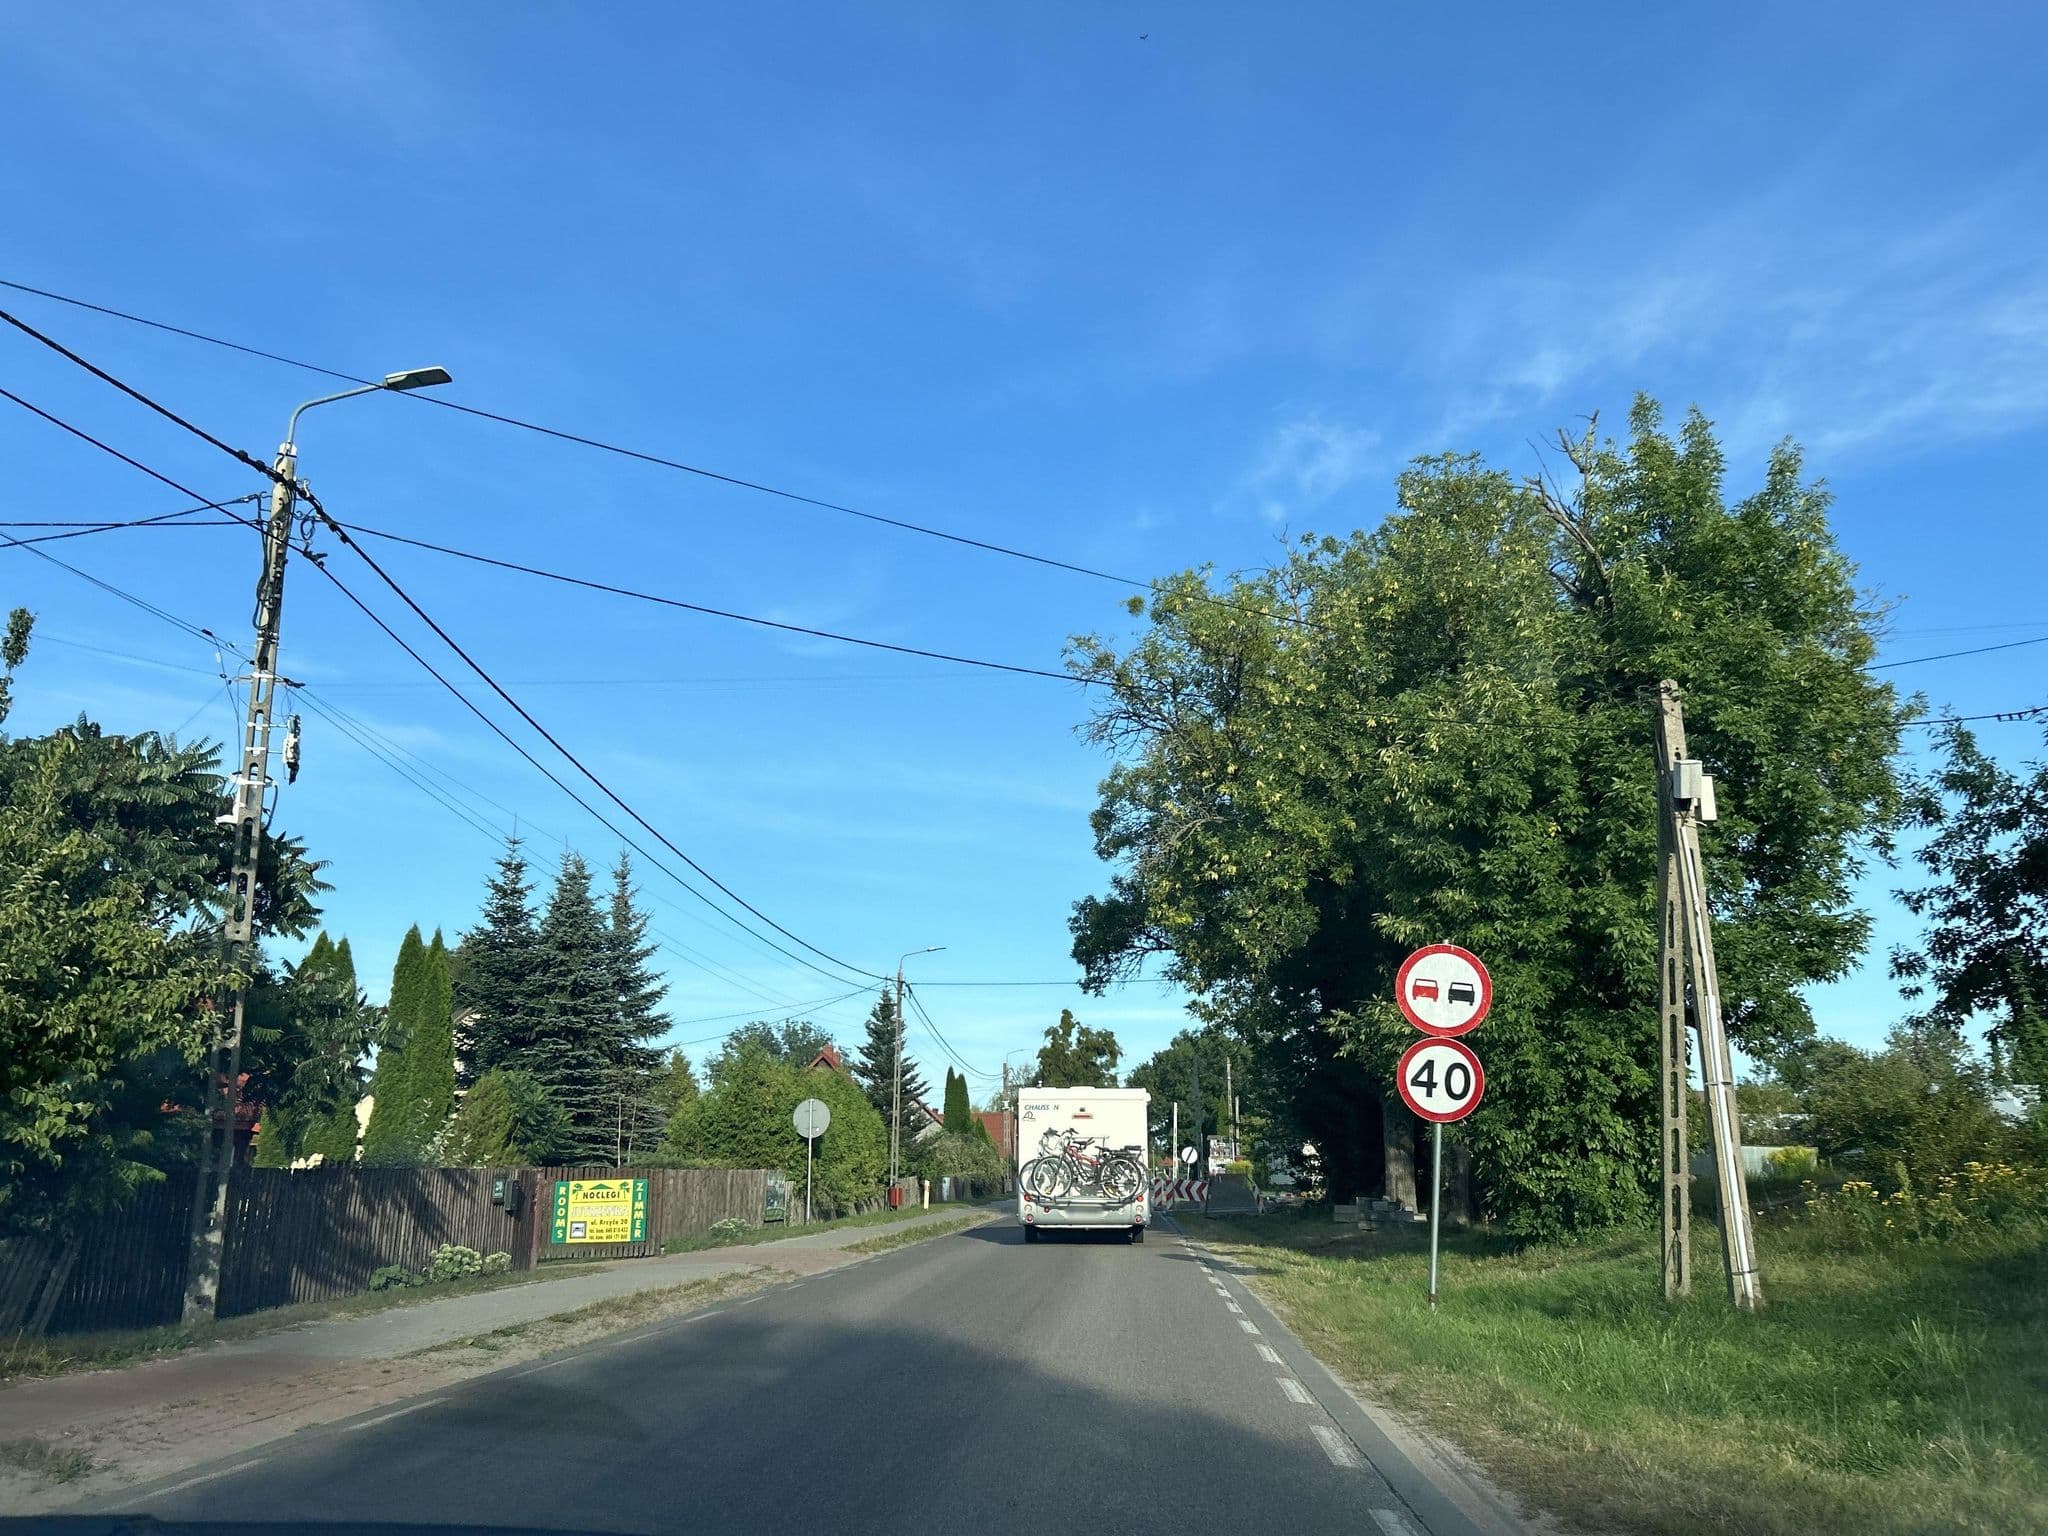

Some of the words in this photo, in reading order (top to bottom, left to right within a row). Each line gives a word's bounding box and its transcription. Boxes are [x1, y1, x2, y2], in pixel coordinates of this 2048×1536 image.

[1410, 1059, 1471, 1101] 40
[556, 1187, 566, 1238] ROOMS
[634, 1183, 644, 1238] ZIMMER
